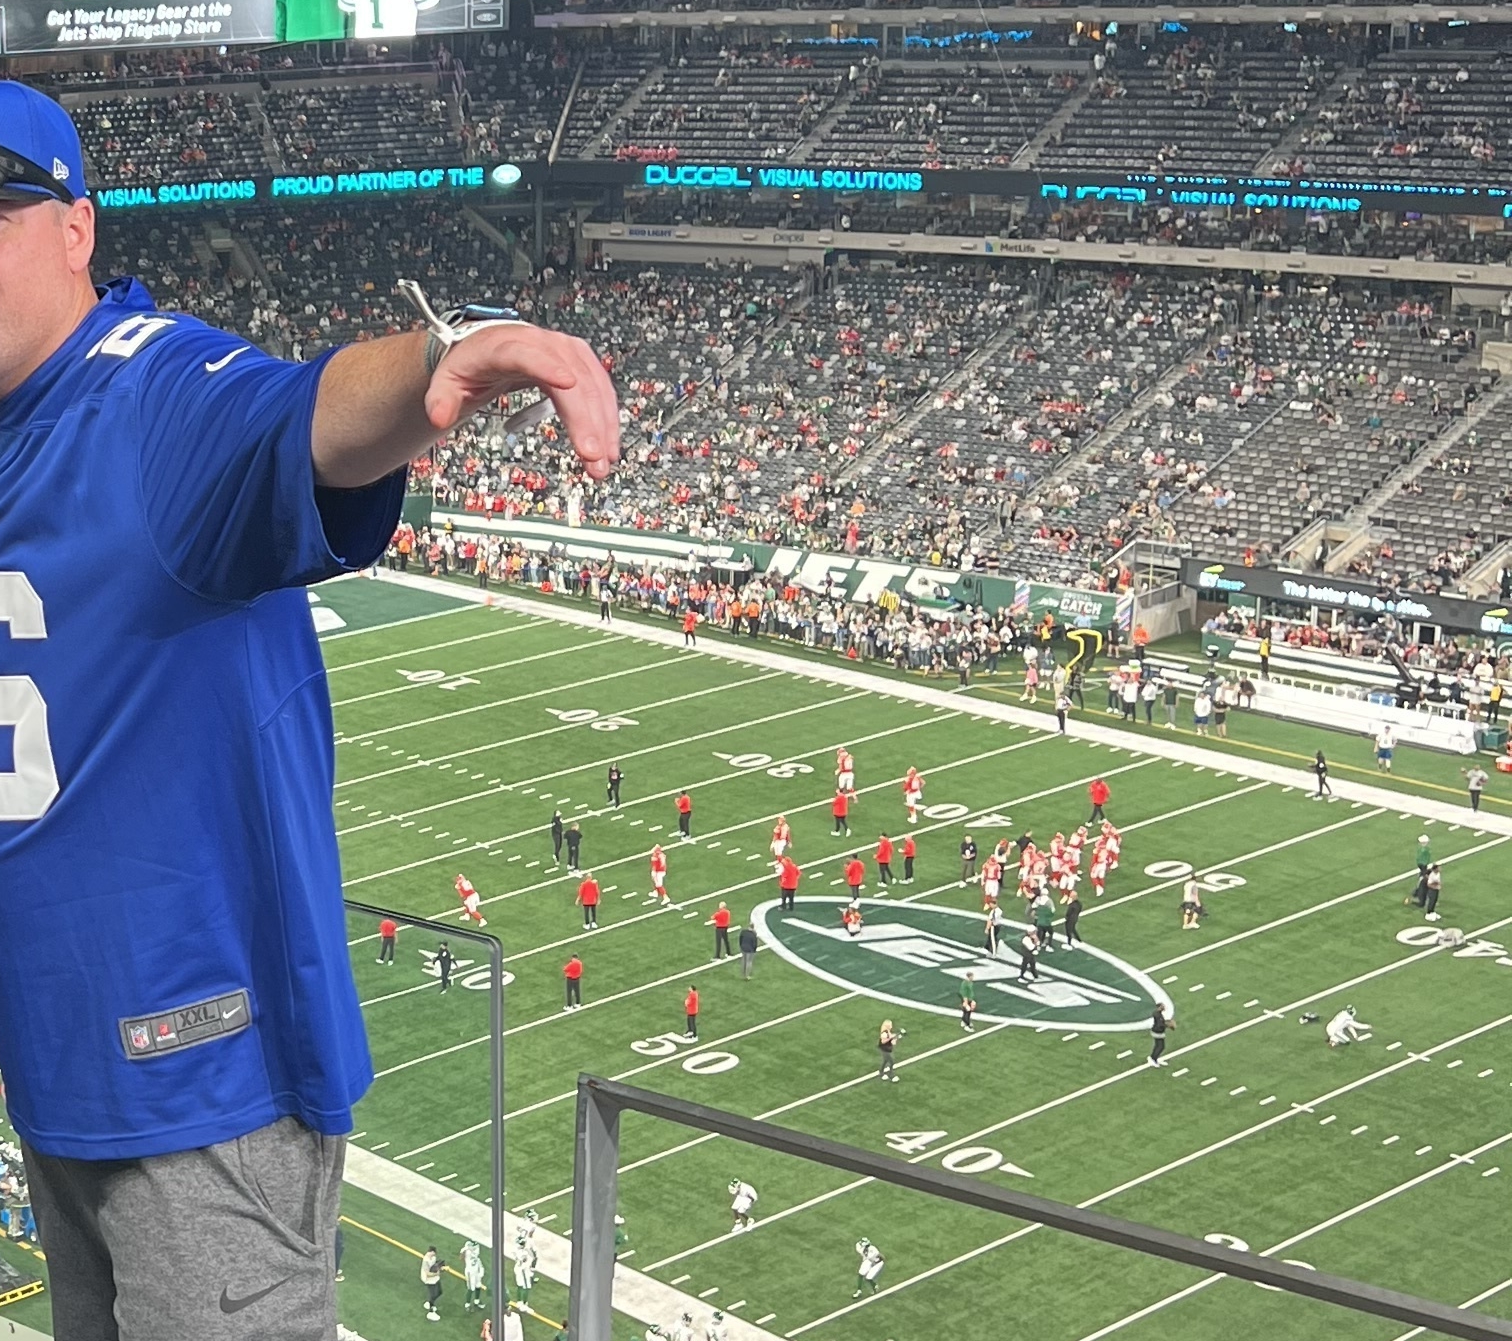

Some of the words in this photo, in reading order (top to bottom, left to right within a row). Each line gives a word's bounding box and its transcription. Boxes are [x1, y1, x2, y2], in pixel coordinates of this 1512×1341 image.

[47, 9, 73, 26] Get
[74, 6, 104, 24] Your
[105, 5, 156, 26] Legacy
[157, 3, 188, 20] Gear
[190, 3, 205, 18] at
[207, 1, 233, 17] the
[57, 25, 86, 42] Jets
[88, 23, 122, 41] Shop
[125, 20, 182, 41] Flagship
[184, 18, 222, 34] Store
[97, 186, 156, 208] VISUAL
[158, 180, 256, 204] SOLUTIONS
[273, 175, 333, 197] PROUD
[337, 170, 417, 192] PARTNER
[419, 168, 445, 188] OF
[447, 166, 484, 187] THE
[645, 163, 750, 187] DUGGAL
[758, 168, 819, 189] VISUAL
[821, 170, 923, 191] SOLUTIONS
[999, 243, 1036, 254] MetLife
[1281, 580, 1306, 598] The
[1059, 598, 1103, 615] CATCH
[178, 1006, 216, 1028] XXL
[884, 1129, 1005, 1175] 40
